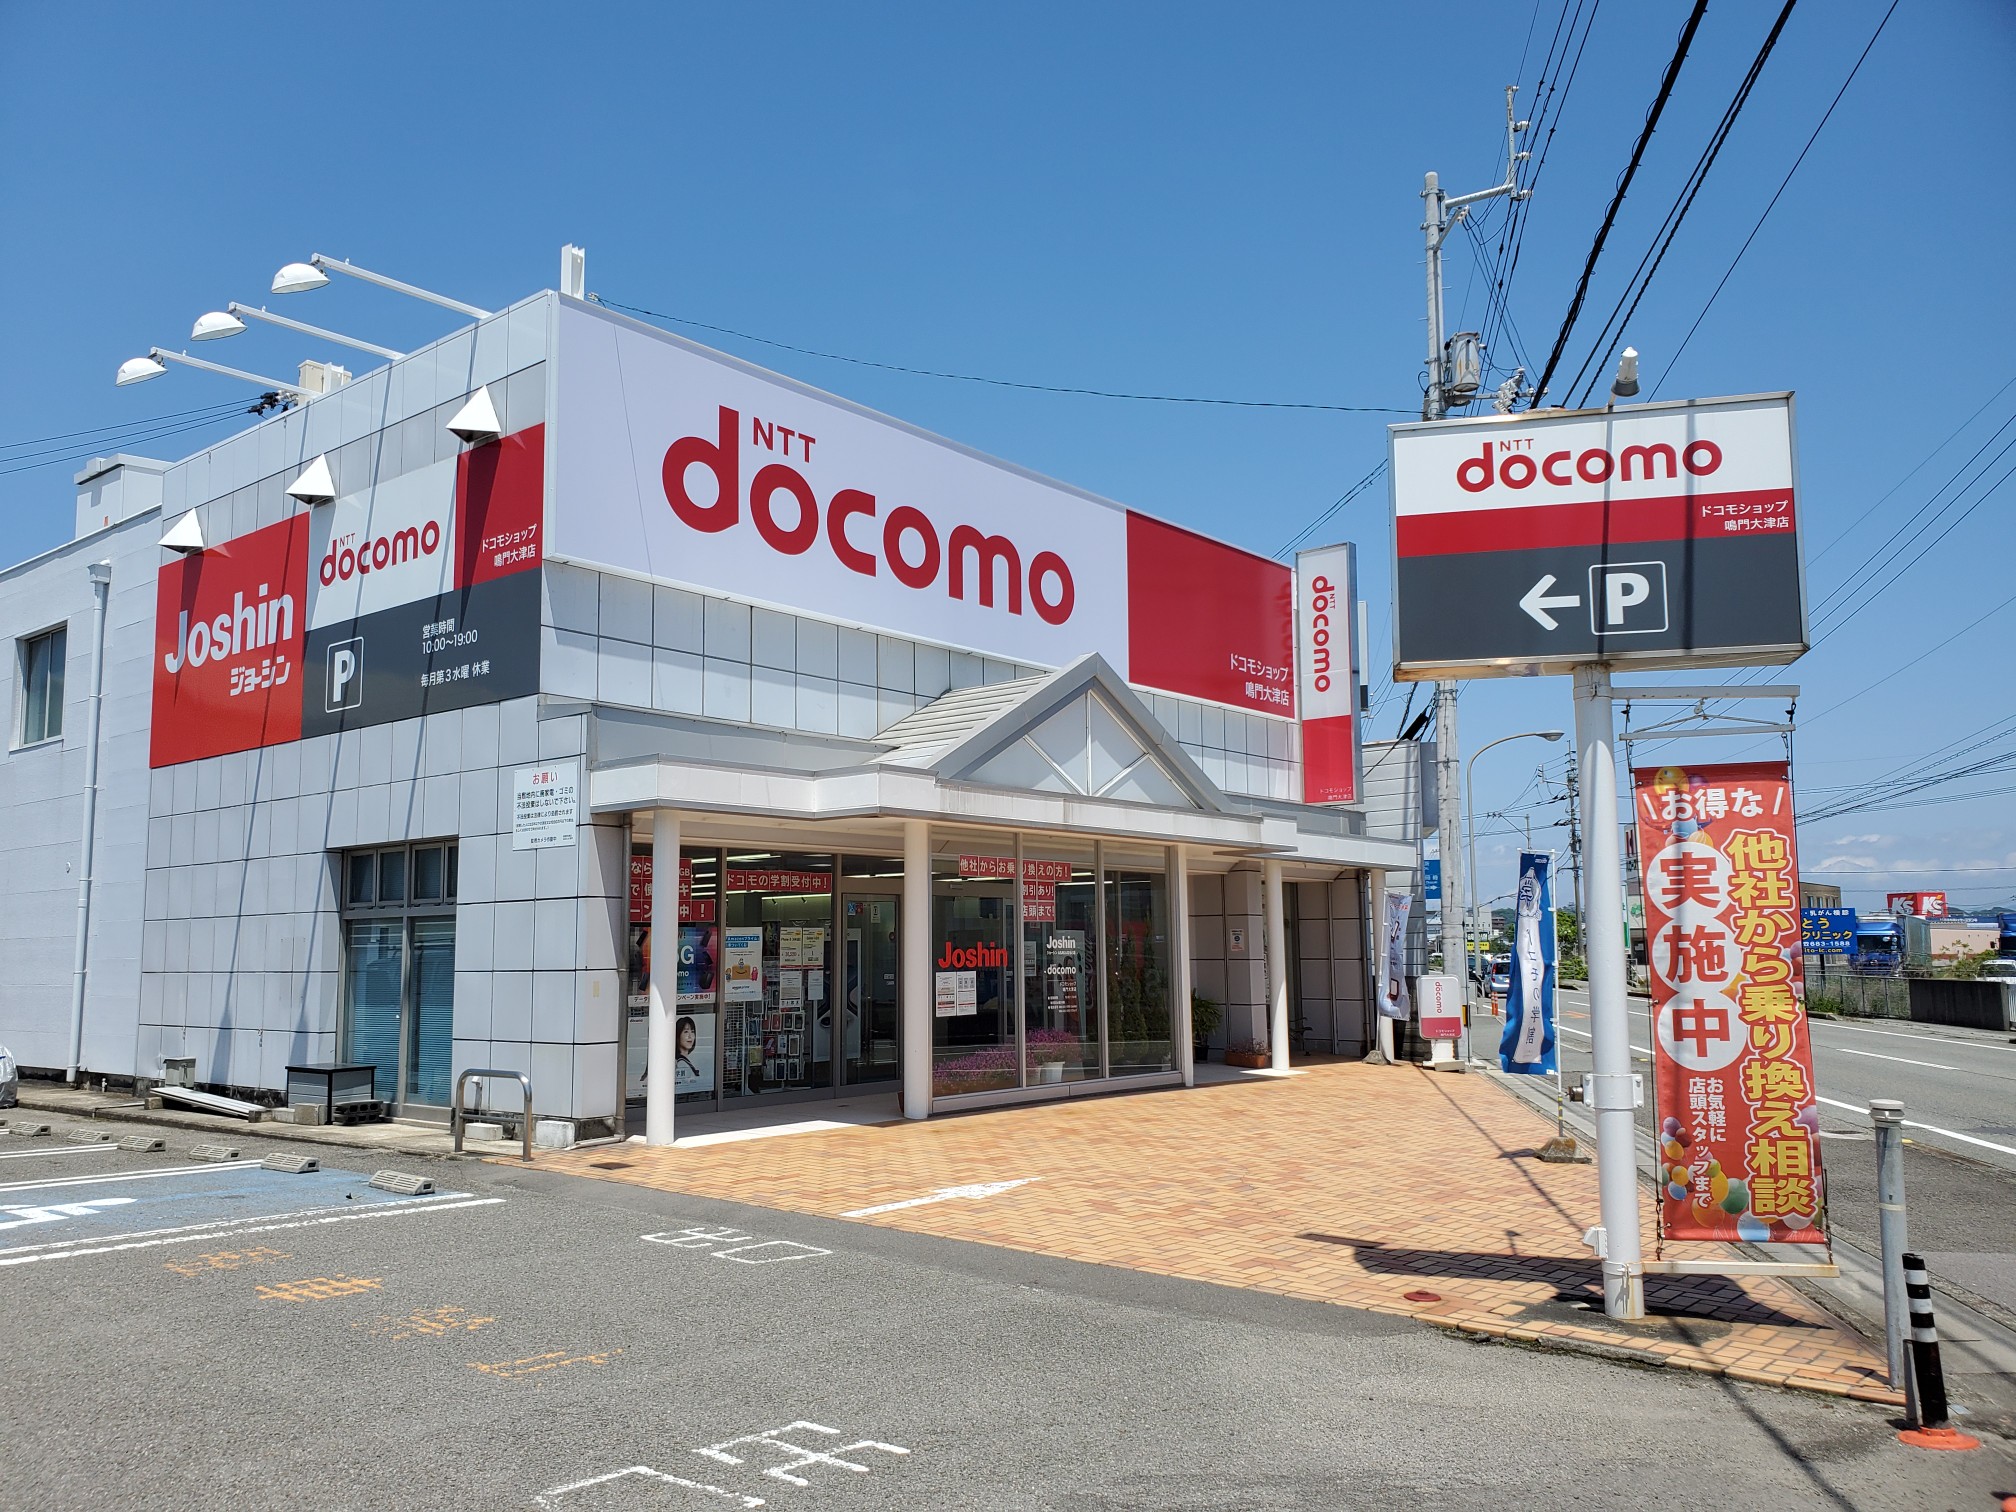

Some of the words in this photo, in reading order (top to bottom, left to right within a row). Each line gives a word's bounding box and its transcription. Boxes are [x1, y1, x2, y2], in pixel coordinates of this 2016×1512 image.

[753, 416, 816, 463] NTT
[1499, 438, 1534, 452] NTT
[1456, 439, 1723, 493] docomo
[662, 405, 1075, 626] docomo
[1702, 500, 1788, 517] ドコモショップ
[482, 523, 537, 553] ドコモショップ
[1724, 516, 1789, 531] 鳴門大津店
[320, 520, 440, 587] docomo
[339, 533, 355, 547] NTT
[494, 544, 536, 567] 鳴門大津店
[1605, 572, 1649, 625] P
[165, 583, 294, 674] Joshin
[422, 618, 455, 639] 営業時間
[1312, 576, 1335, 692] docomo
[230, 655, 291, 696] ジョーシン
[333, 650, 356, 702] P
[420, 664, 469, 688] 毎月第3水曜
[472, 660, 490, 677] 休業
[1230, 653, 1288, 682] ドコモショップ
[1246, 682, 1289, 706] 鳴門大津店
[532, 772, 558, 785] お願い
[1661, 787, 1764, 821] お得な
[1802, 918, 1830, 929] とう
[1802, 930, 1852, 940] クリニック
[677, 945, 694, 965] G
[938, 941, 1008, 968] Joshin
[1046, 936, 1076, 949] Joshin
[1660, 852, 1731, 1058] 実施中
[1047, 966, 1077, 975] docomo
[1727, 833, 1812, 1214] 他社から乗り換え相談
[1706, 1077, 1727, 1143] お気軽に
[1689, 1077, 1712, 1208] 店頭スタッフまで
[640, 1226, 833, 1264] 出口
